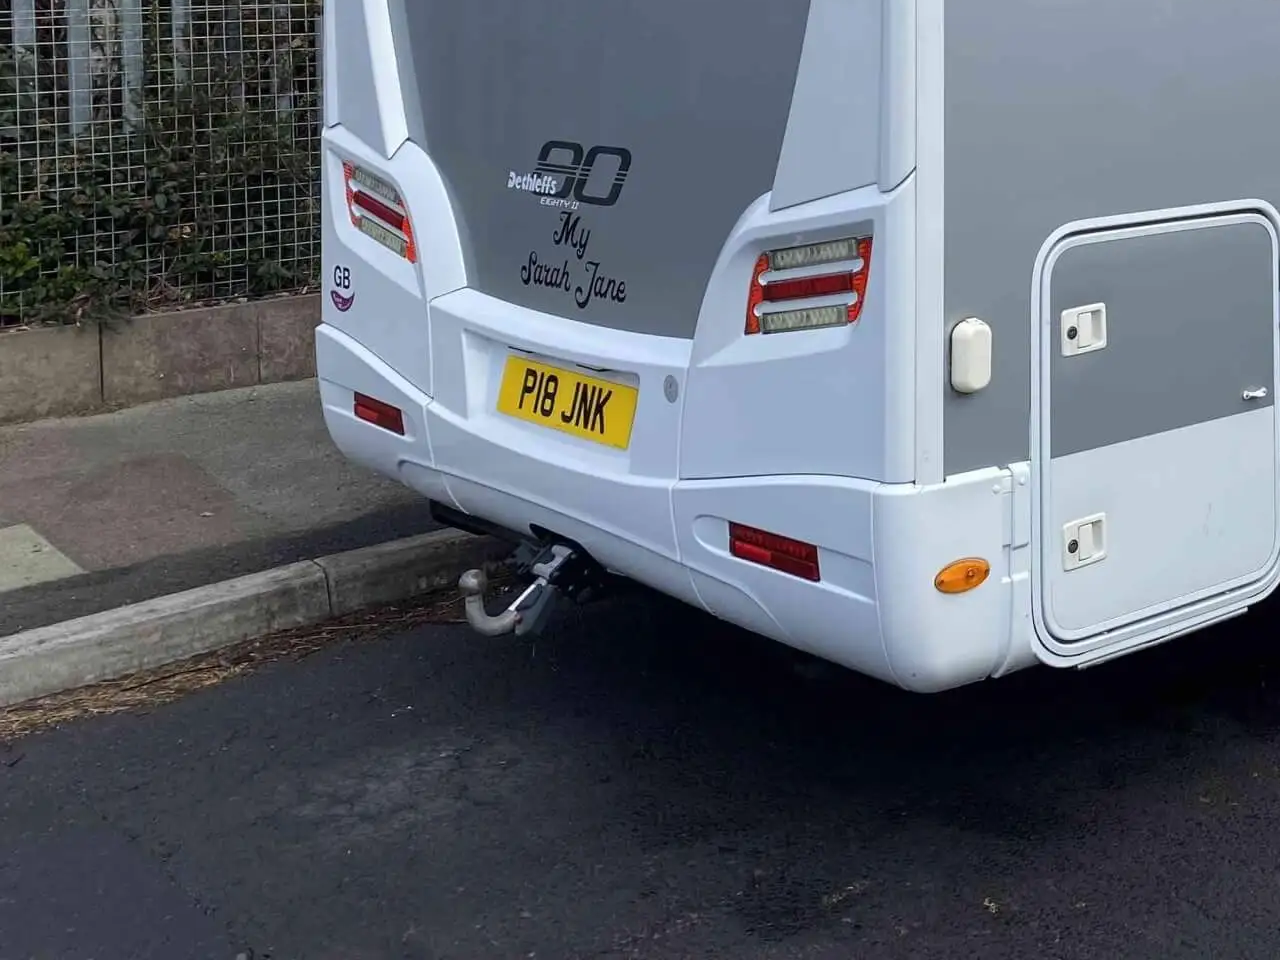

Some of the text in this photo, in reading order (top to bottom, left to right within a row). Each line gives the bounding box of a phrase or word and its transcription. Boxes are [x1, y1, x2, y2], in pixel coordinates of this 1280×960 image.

[507, 171, 557, 195] Dethleffs
[553, 211, 591, 260] My
[334, 265, 350, 289] GB
[520, 251, 627, 309] Sarah Jane
[518, 367, 613, 434] P18 JNK
